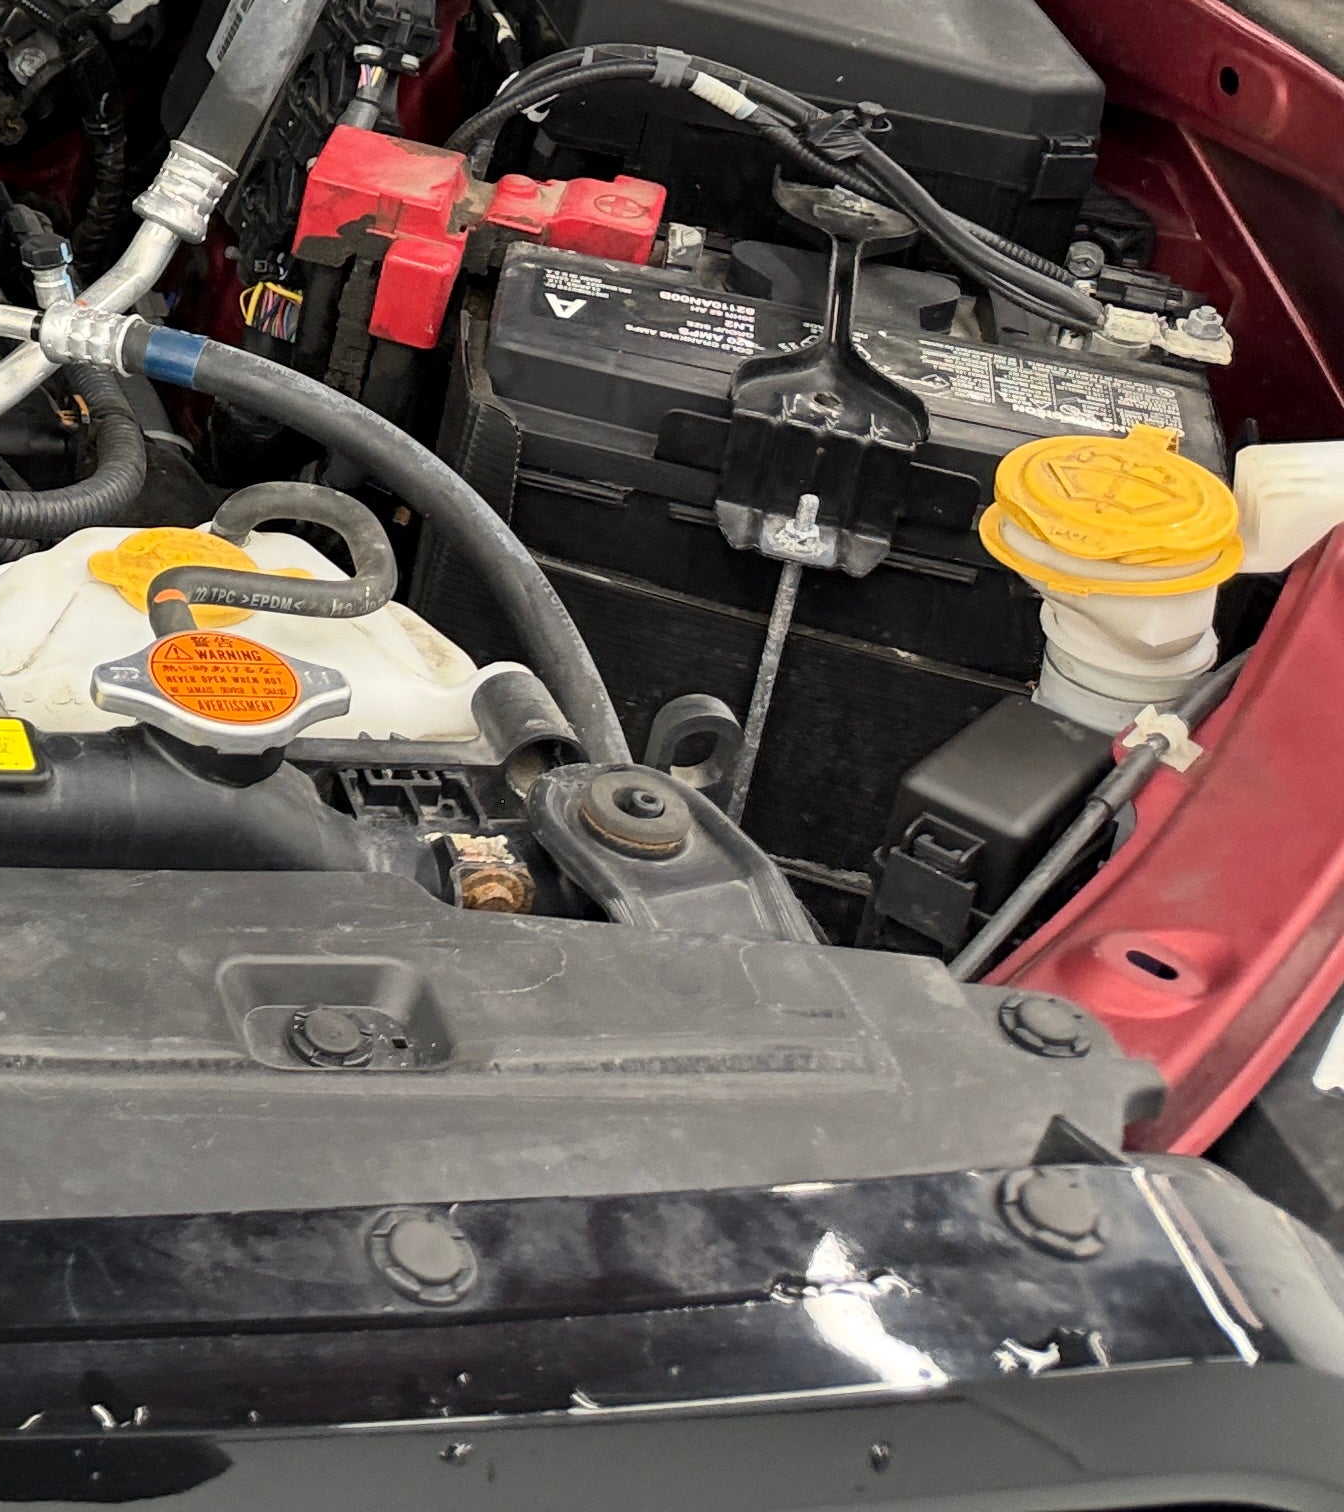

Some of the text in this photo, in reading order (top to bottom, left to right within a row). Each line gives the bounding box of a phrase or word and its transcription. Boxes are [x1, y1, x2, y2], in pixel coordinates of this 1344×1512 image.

[544, 292, 588, 319] A
[685, 320, 755, 339] GROUP SIZE
[724, 319, 755, 332] LN2
[625, 323, 754, 355] COLD CRANKING AMPS
[678, 327, 724, 342] AMPS
[210, 587, 237, 604] TPC
[194, 649, 262, 662] WARNING
